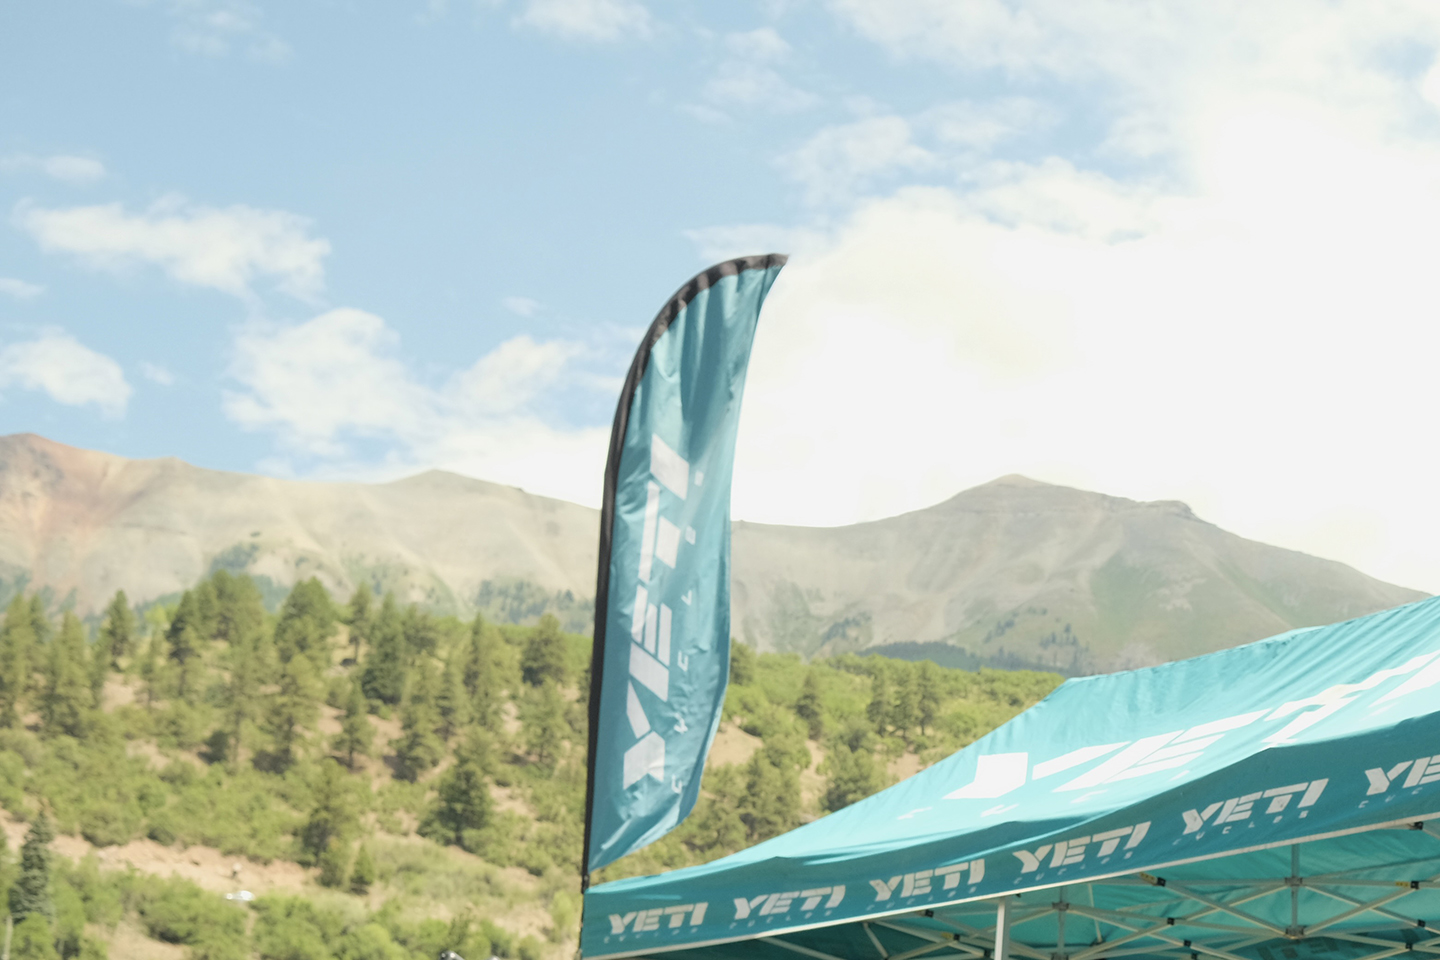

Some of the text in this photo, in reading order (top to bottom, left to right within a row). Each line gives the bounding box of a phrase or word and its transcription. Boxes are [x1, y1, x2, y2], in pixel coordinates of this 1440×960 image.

[622, 433, 690, 790] YETI
[1182, 778, 1329, 835] YETI
[1012, 821, 1152, 874] YETI
[733, 885, 846, 920] YETI
[869, 859, 985, 901] YETI
[608, 902, 709, 935] YETI
